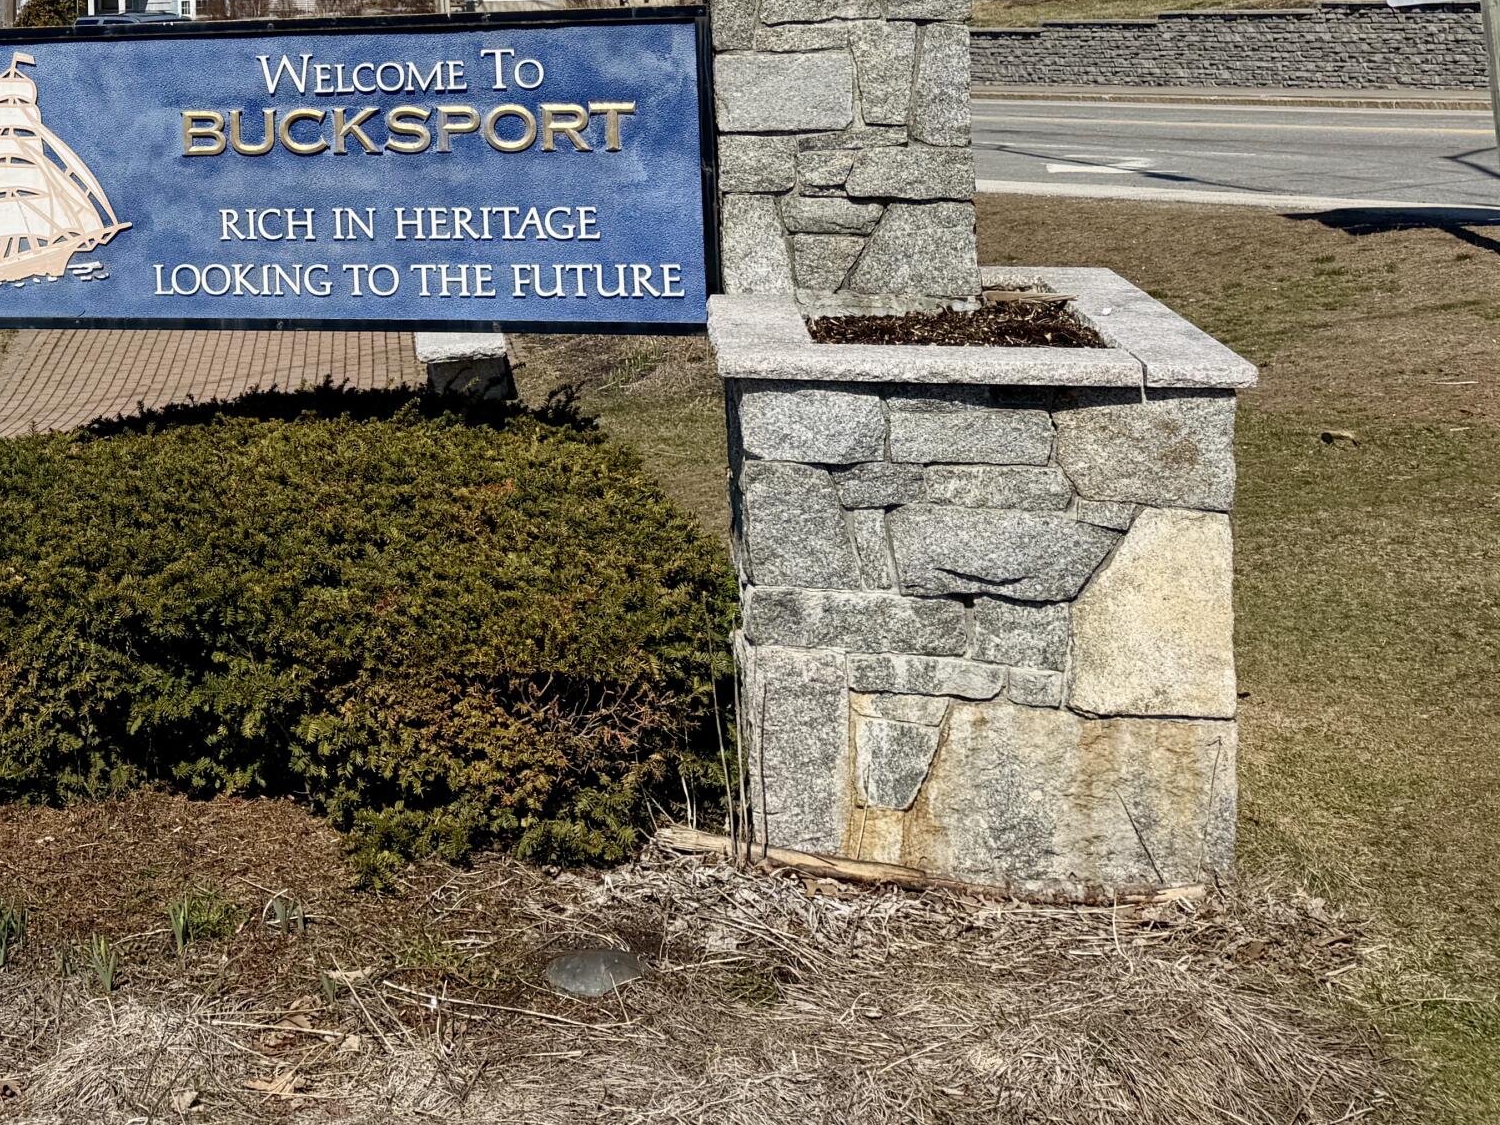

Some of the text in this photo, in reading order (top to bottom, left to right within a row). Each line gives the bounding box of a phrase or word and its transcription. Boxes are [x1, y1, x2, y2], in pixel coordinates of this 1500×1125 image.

[181, 101, 636, 155] BUCKSPORT
[219, 206, 600, 240] RICH IN HERITAGE
[153, 263, 684, 297] LOOKING TO THE FUTURE
